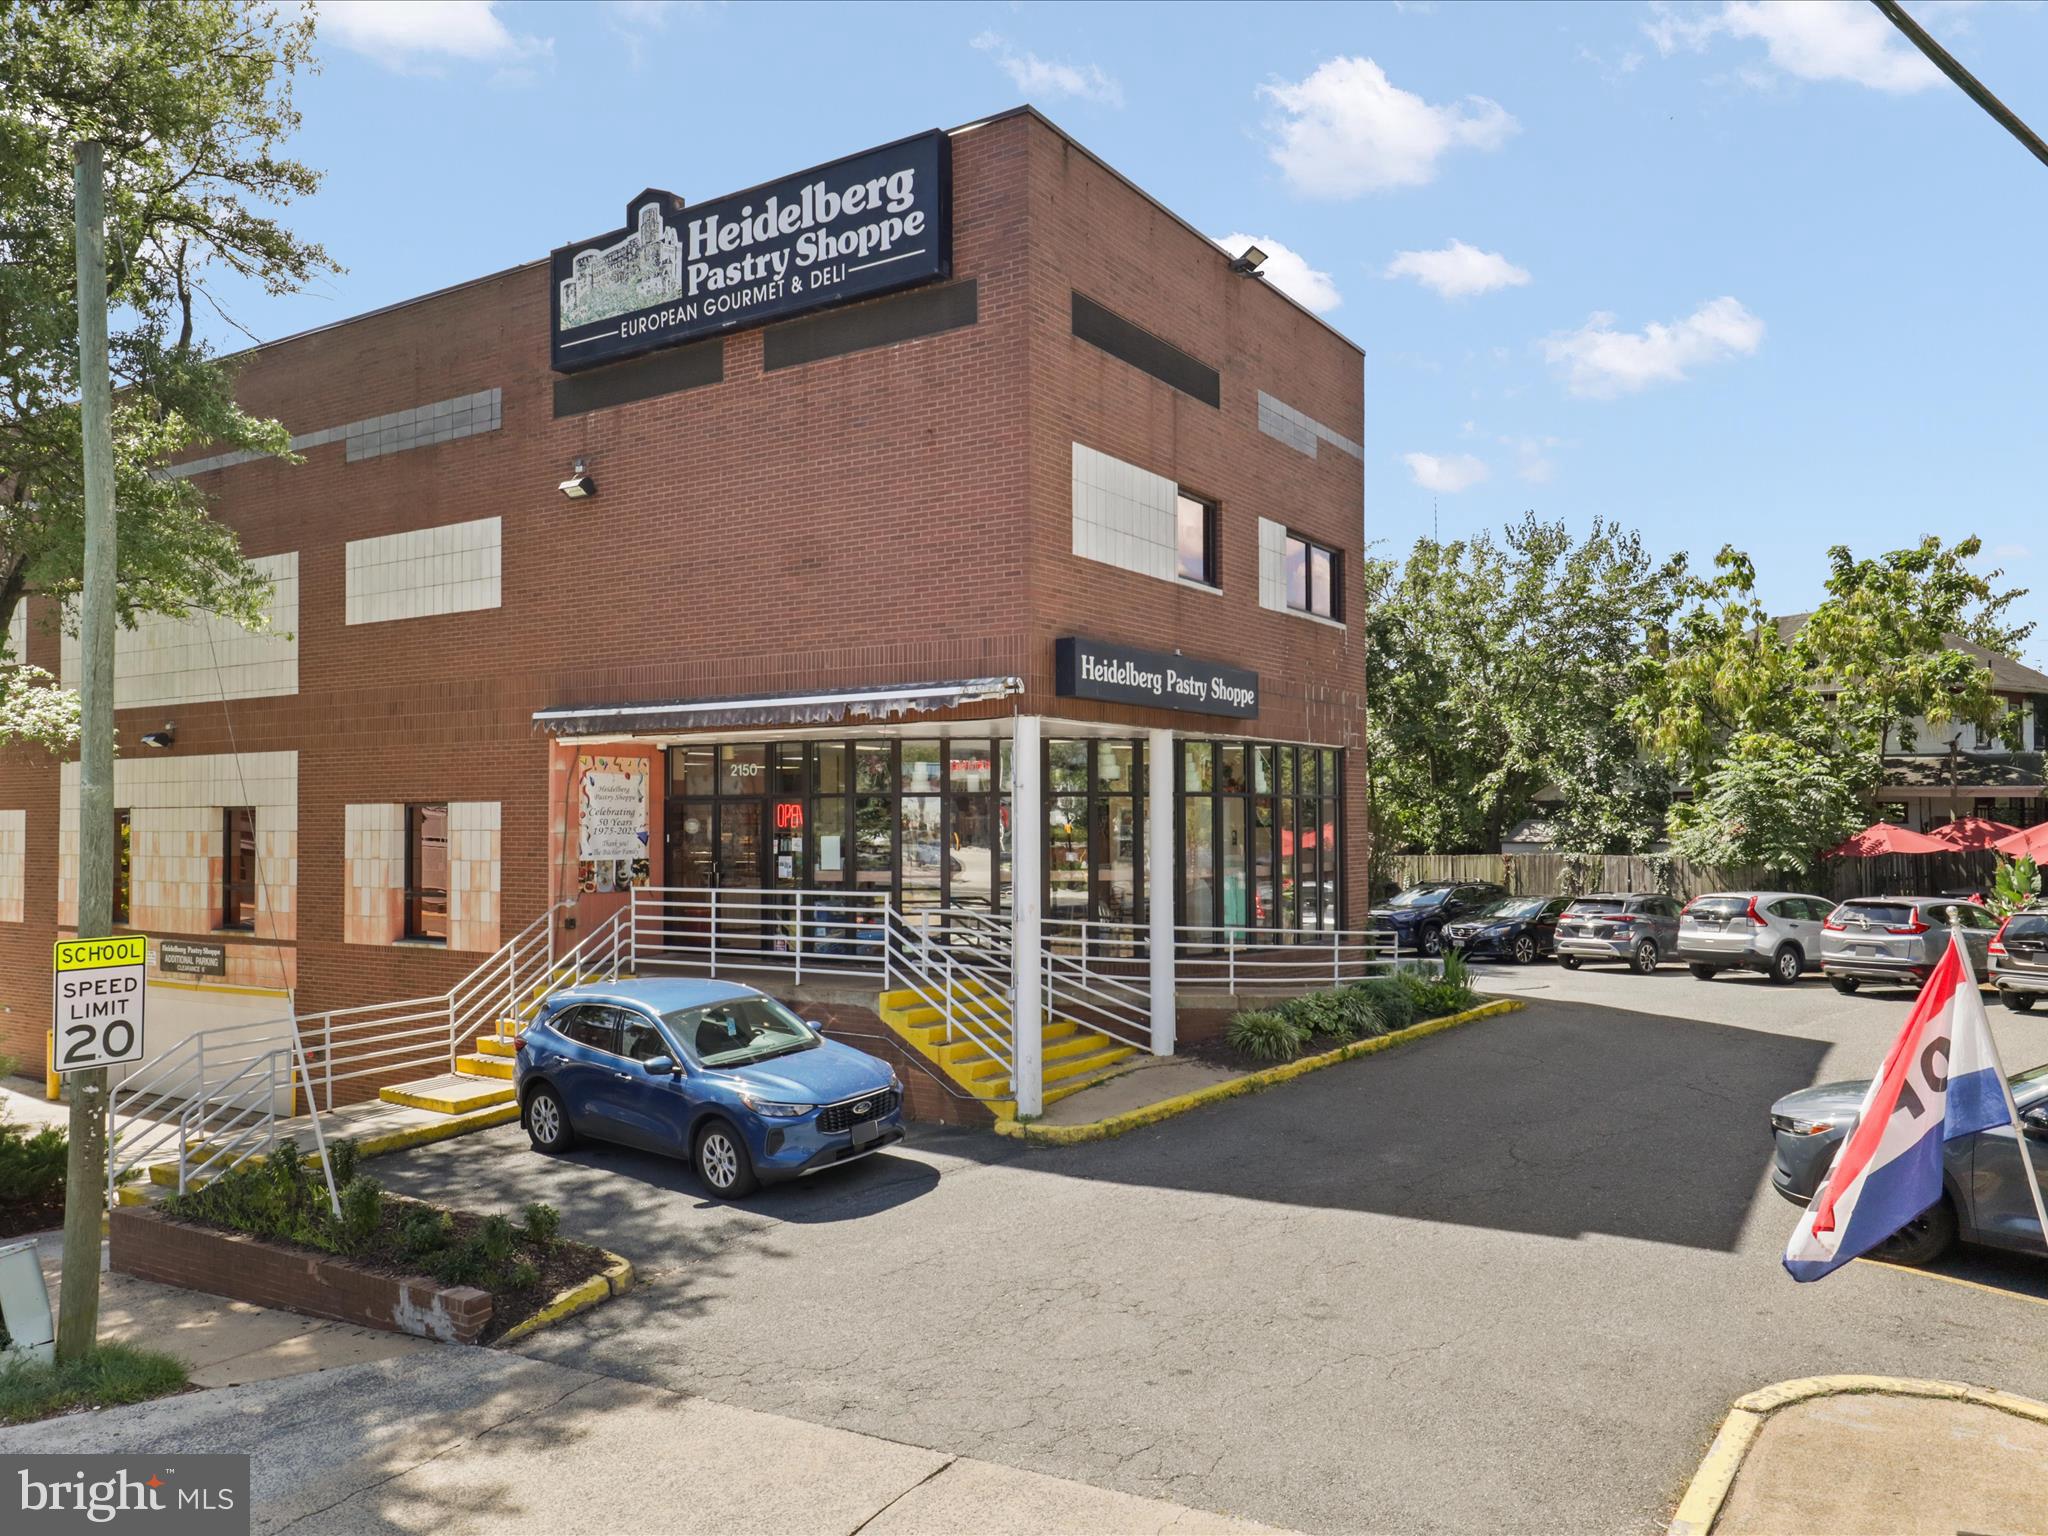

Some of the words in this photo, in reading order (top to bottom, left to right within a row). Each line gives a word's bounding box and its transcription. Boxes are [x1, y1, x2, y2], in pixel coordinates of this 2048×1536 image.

[687, 168, 915, 261] Heidelberg
[687, 247, 790, 296] Pastry
[795, 210, 925, 266] Shoppe
[620, 303, 698, 339] EUROPEAN
[703, 278, 784, 318] GOURMET
[791, 275, 803, 294] &
[810, 263, 846, 290] DELI
[1081, 654, 1162, 695] Heidelberg
[1166, 670, 1207, 701] Pastry
[1211, 677, 1255, 708] Shoppe
[730, 763, 758, 777] 2150
[588, 807, 636, 818] Celebrating
[599, 818, 609, 826] 50
[611, 818, 633, 826] Years
[593, 827, 637, 835] 1975-2025
[62, 944, 140, 963] SCHOOL
[162, 944, 186, 954] Heidelberg
[187, 946, 202, 955] Pastry
[203, 947, 220, 956] Shoppe
[165, 955, 194, 965] ADDITIONAL
[196, 956, 218, 967] PARKING
[63, 977, 137, 998] SPEED
[71, 999, 129, 1020] LIMIT
[63, 1020, 134, 1064] 20
